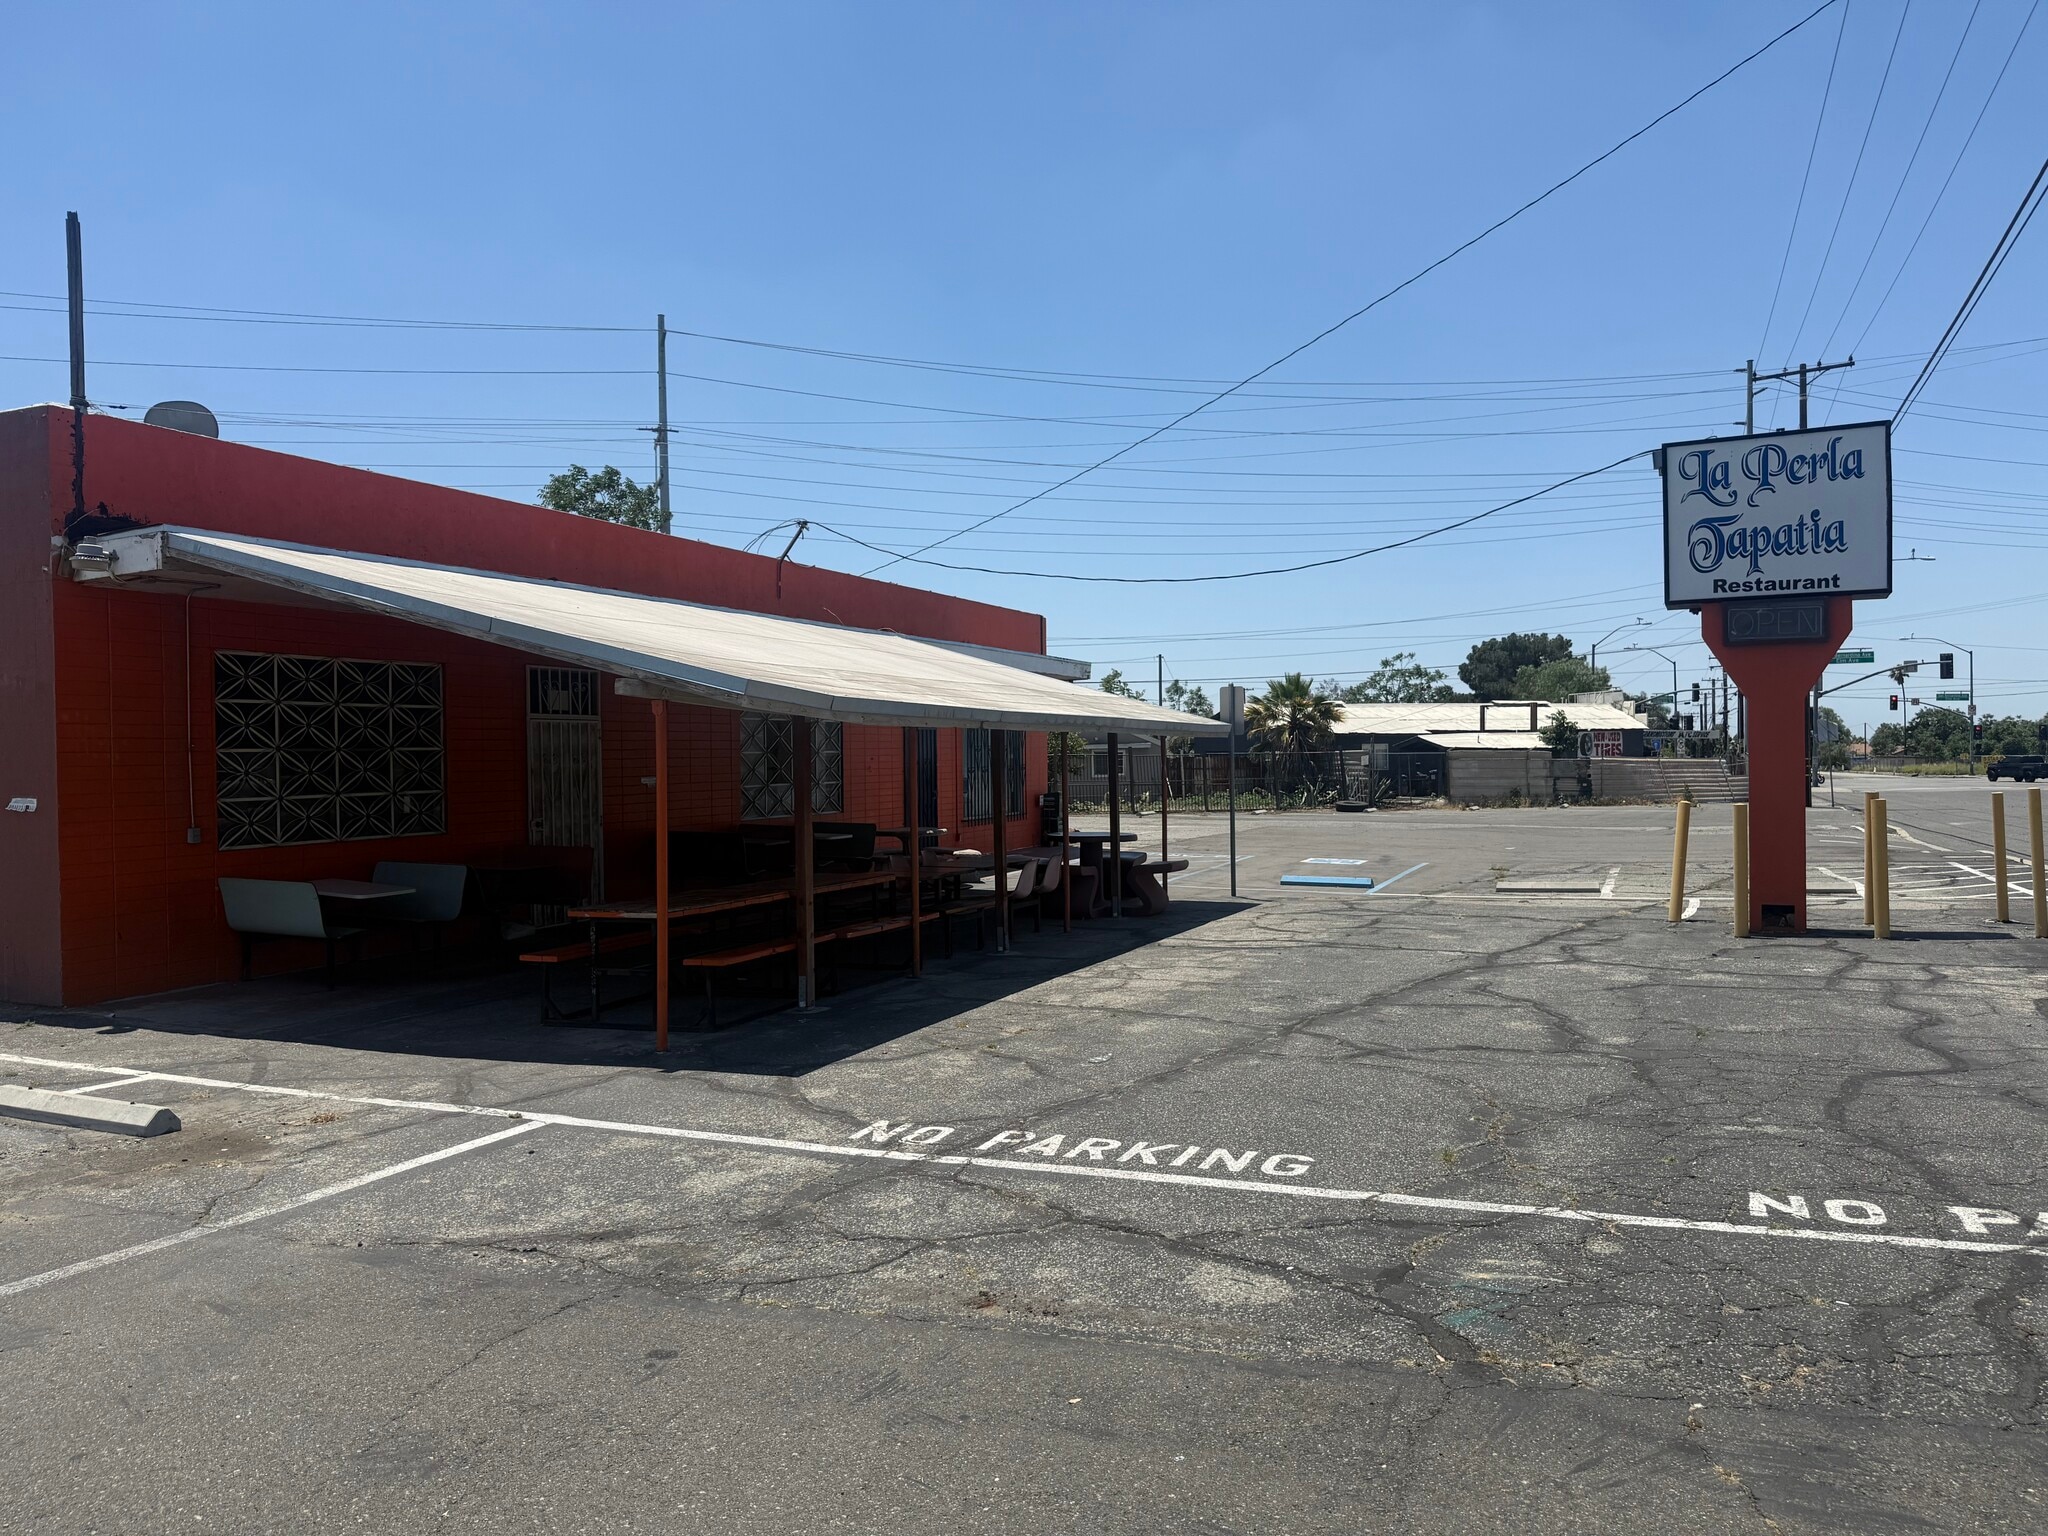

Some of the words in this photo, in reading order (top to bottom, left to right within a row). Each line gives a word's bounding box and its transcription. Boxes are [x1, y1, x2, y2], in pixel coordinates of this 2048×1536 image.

[1679, 449, 1738, 507] La
[1741, 436, 1865, 507] Perla
[1713, 573, 1840, 593] Restaurant
[1732, 609, 1818, 635] OPEN
[1593, 731, 1605, 742] NEW
[1593, 743, 1622, 757] TIRES
[847, 1120, 955, 1145] NO
[974, 1130, 1316, 1176] PARKING
[1748, 1192, 1888, 1225] NO
